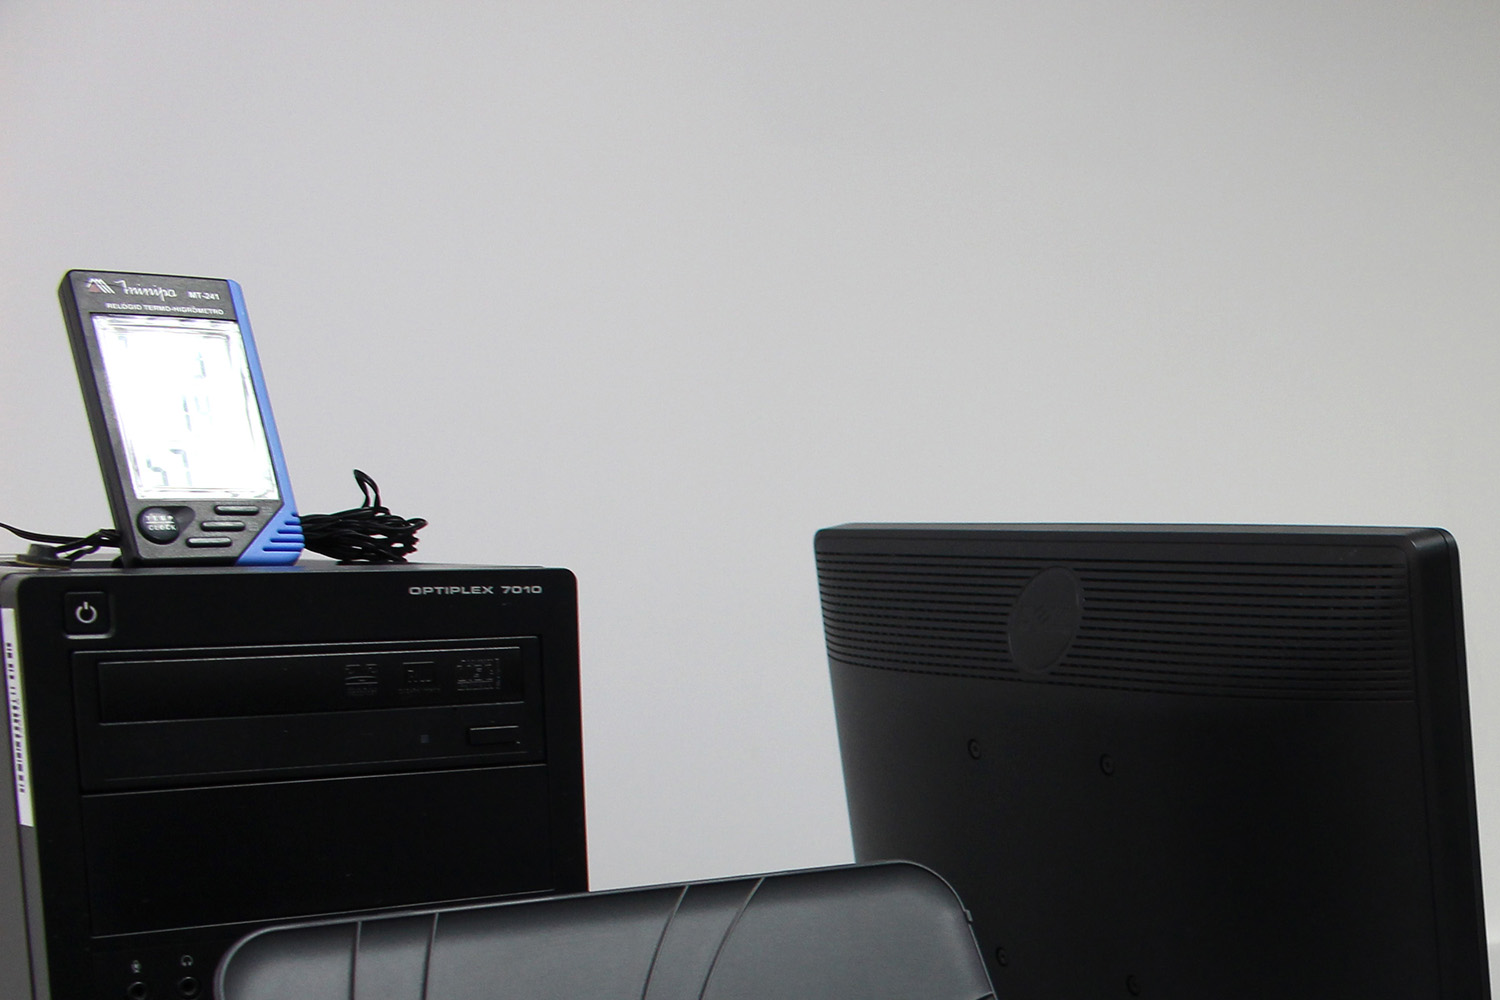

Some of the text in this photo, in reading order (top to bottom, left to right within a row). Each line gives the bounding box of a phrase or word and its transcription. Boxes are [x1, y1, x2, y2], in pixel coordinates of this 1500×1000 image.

[188, 291, 220, 301] MT-241
[408, 585, 543, 596] OPTIPLEX 7010
